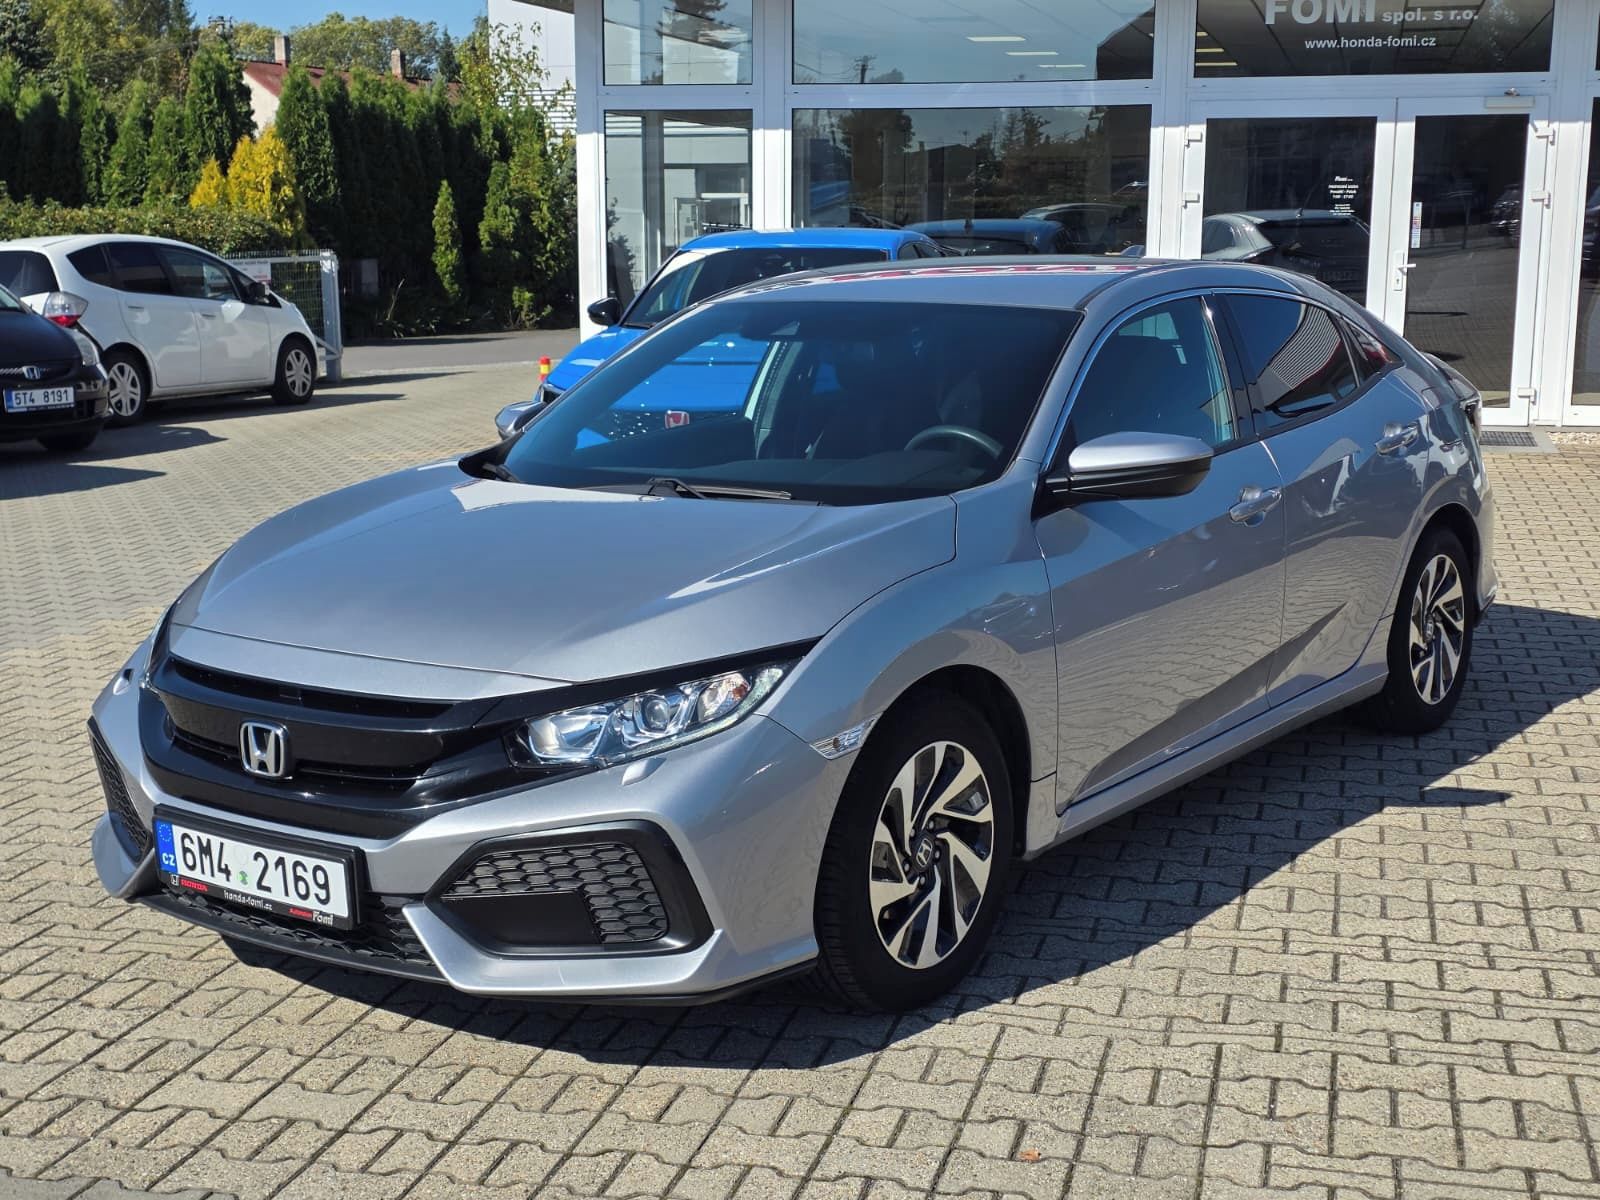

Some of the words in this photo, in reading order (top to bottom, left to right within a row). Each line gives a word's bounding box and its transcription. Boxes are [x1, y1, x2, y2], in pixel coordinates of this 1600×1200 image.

[1265, 0, 1376, 25] FOMI
[1382, 8, 1427, 25] spol.
[1433, 10, 1444, 21] s
[1449, 9, 1479, 21] r.o.
[1304, 35, 1437, 49] www.honda-fomi.cz
[14, 391, 35, 406] 5T4
[43, 389, 69, 404] 8191
[161, 852, 176, 867] CZ
[180, 832, 232, 882] 6M4
[253, 851, 331, 906] 2169
[223, 888, 273, 912] honda-fomi.cz
[312, 909, 334, 926] Fomi
